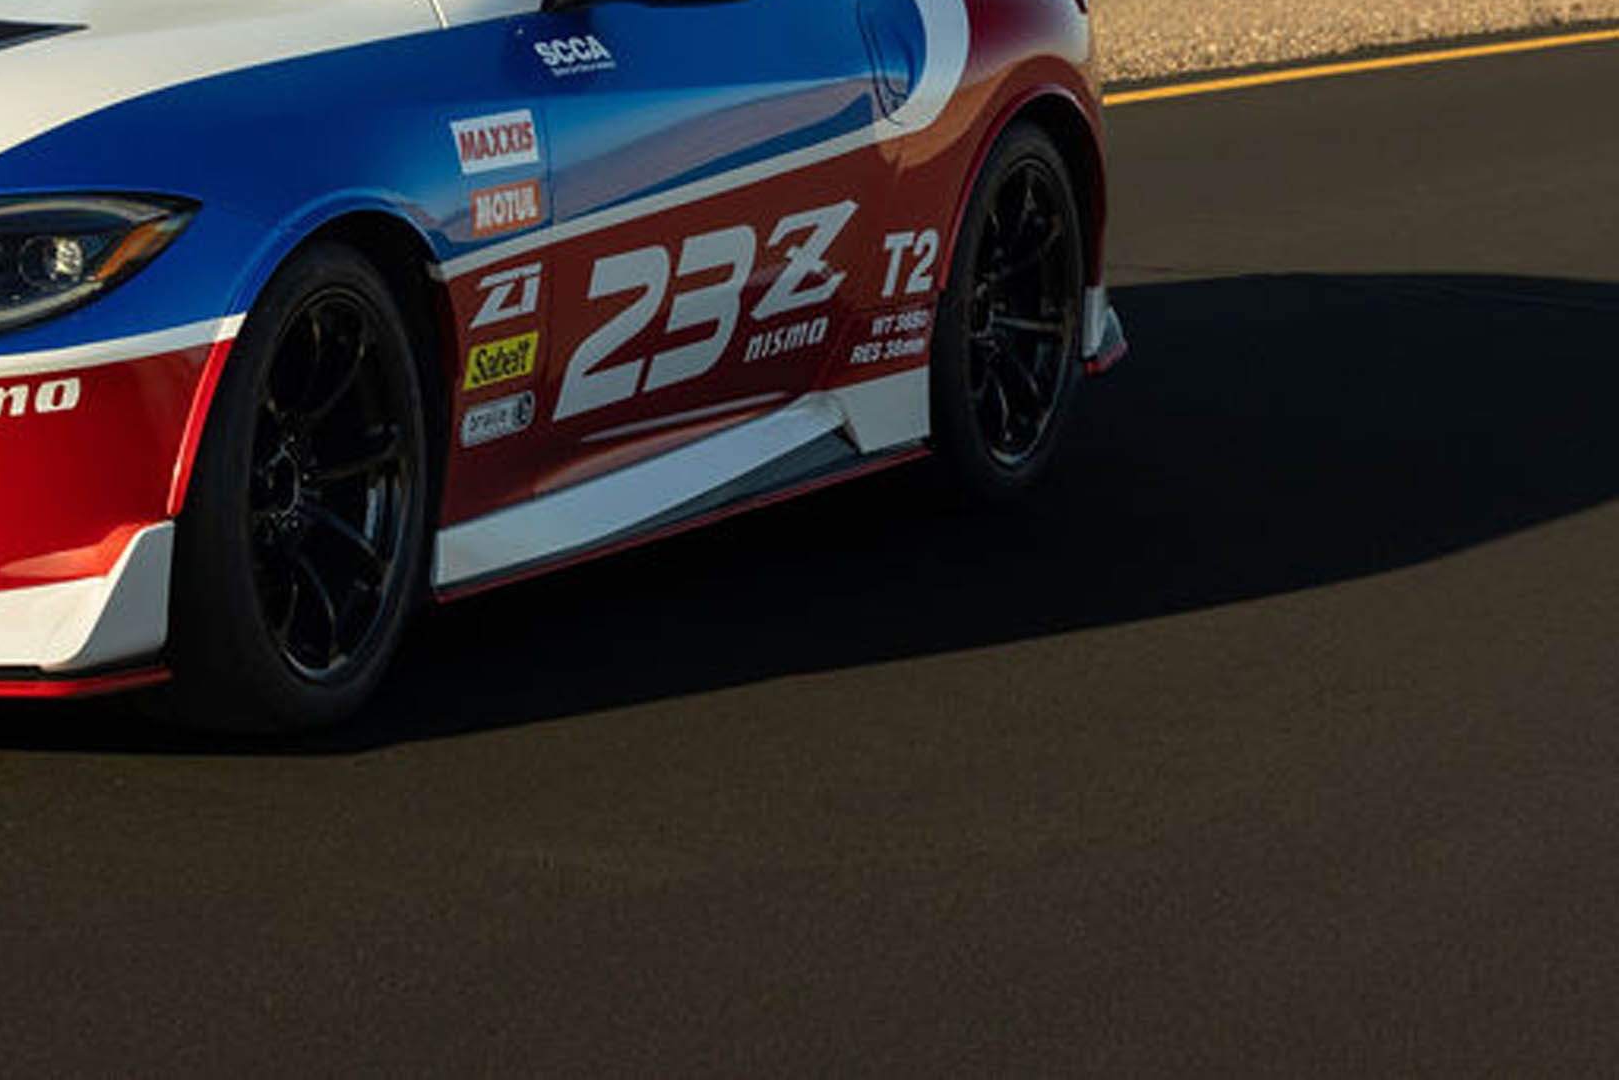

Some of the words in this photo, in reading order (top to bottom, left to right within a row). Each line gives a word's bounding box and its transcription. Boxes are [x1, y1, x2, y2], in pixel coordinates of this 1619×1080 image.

[534, 35, 612, 66] SCCA
[458, 121, 535, 162] MAXXIS
[474, 185, 539, 230] MOTUL
[882, 228, 939, 298] T2
[552, 223, 757, 422] 23
